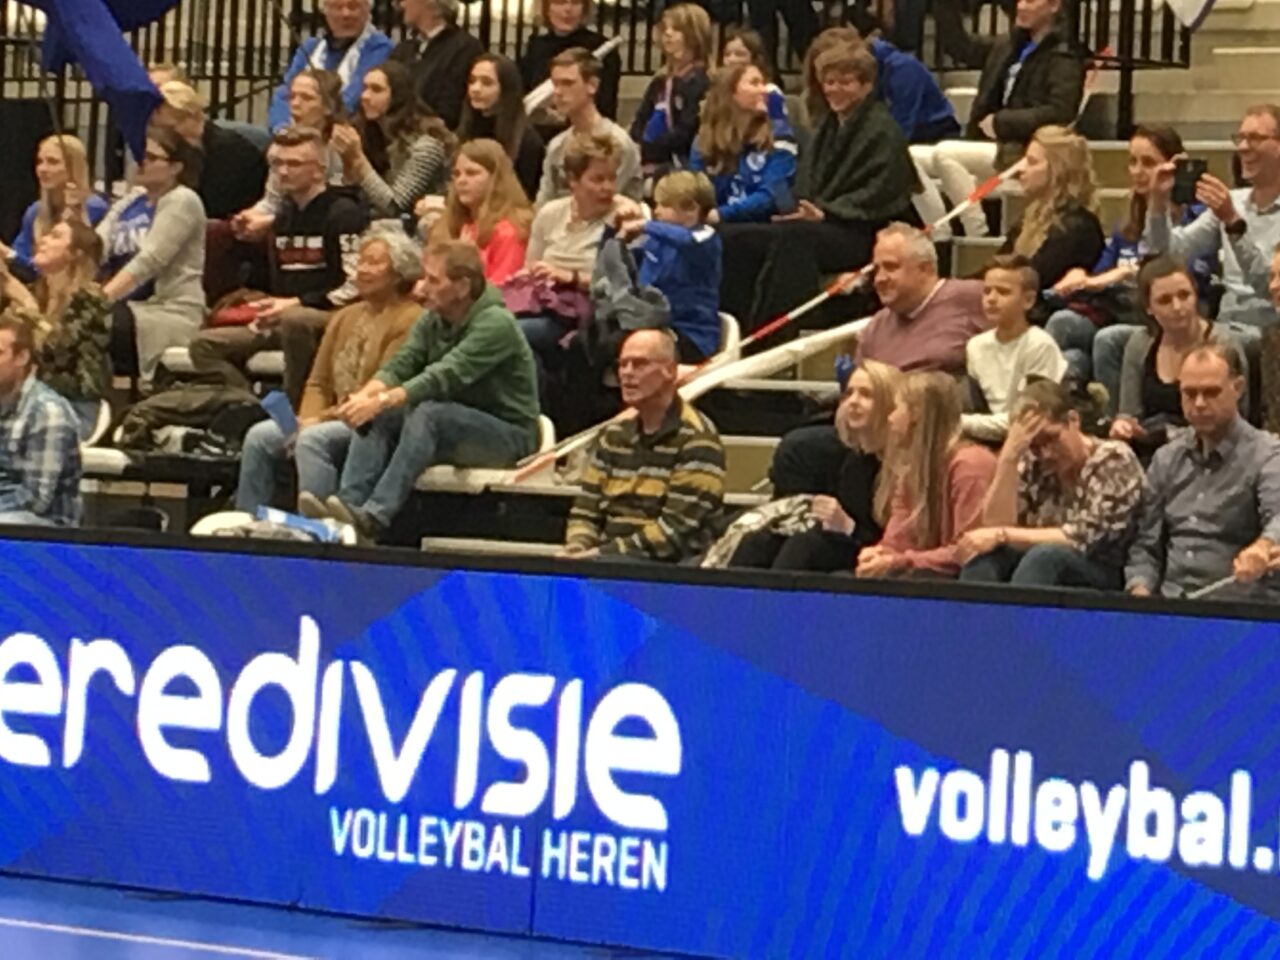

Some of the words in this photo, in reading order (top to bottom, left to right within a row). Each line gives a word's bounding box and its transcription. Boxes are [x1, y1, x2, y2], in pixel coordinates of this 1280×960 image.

[0, 614, 683, 832] eredivisie
[330, 808, 531, 877] VOLLEYBAL
[541, 829, 668, 891] HEREN
